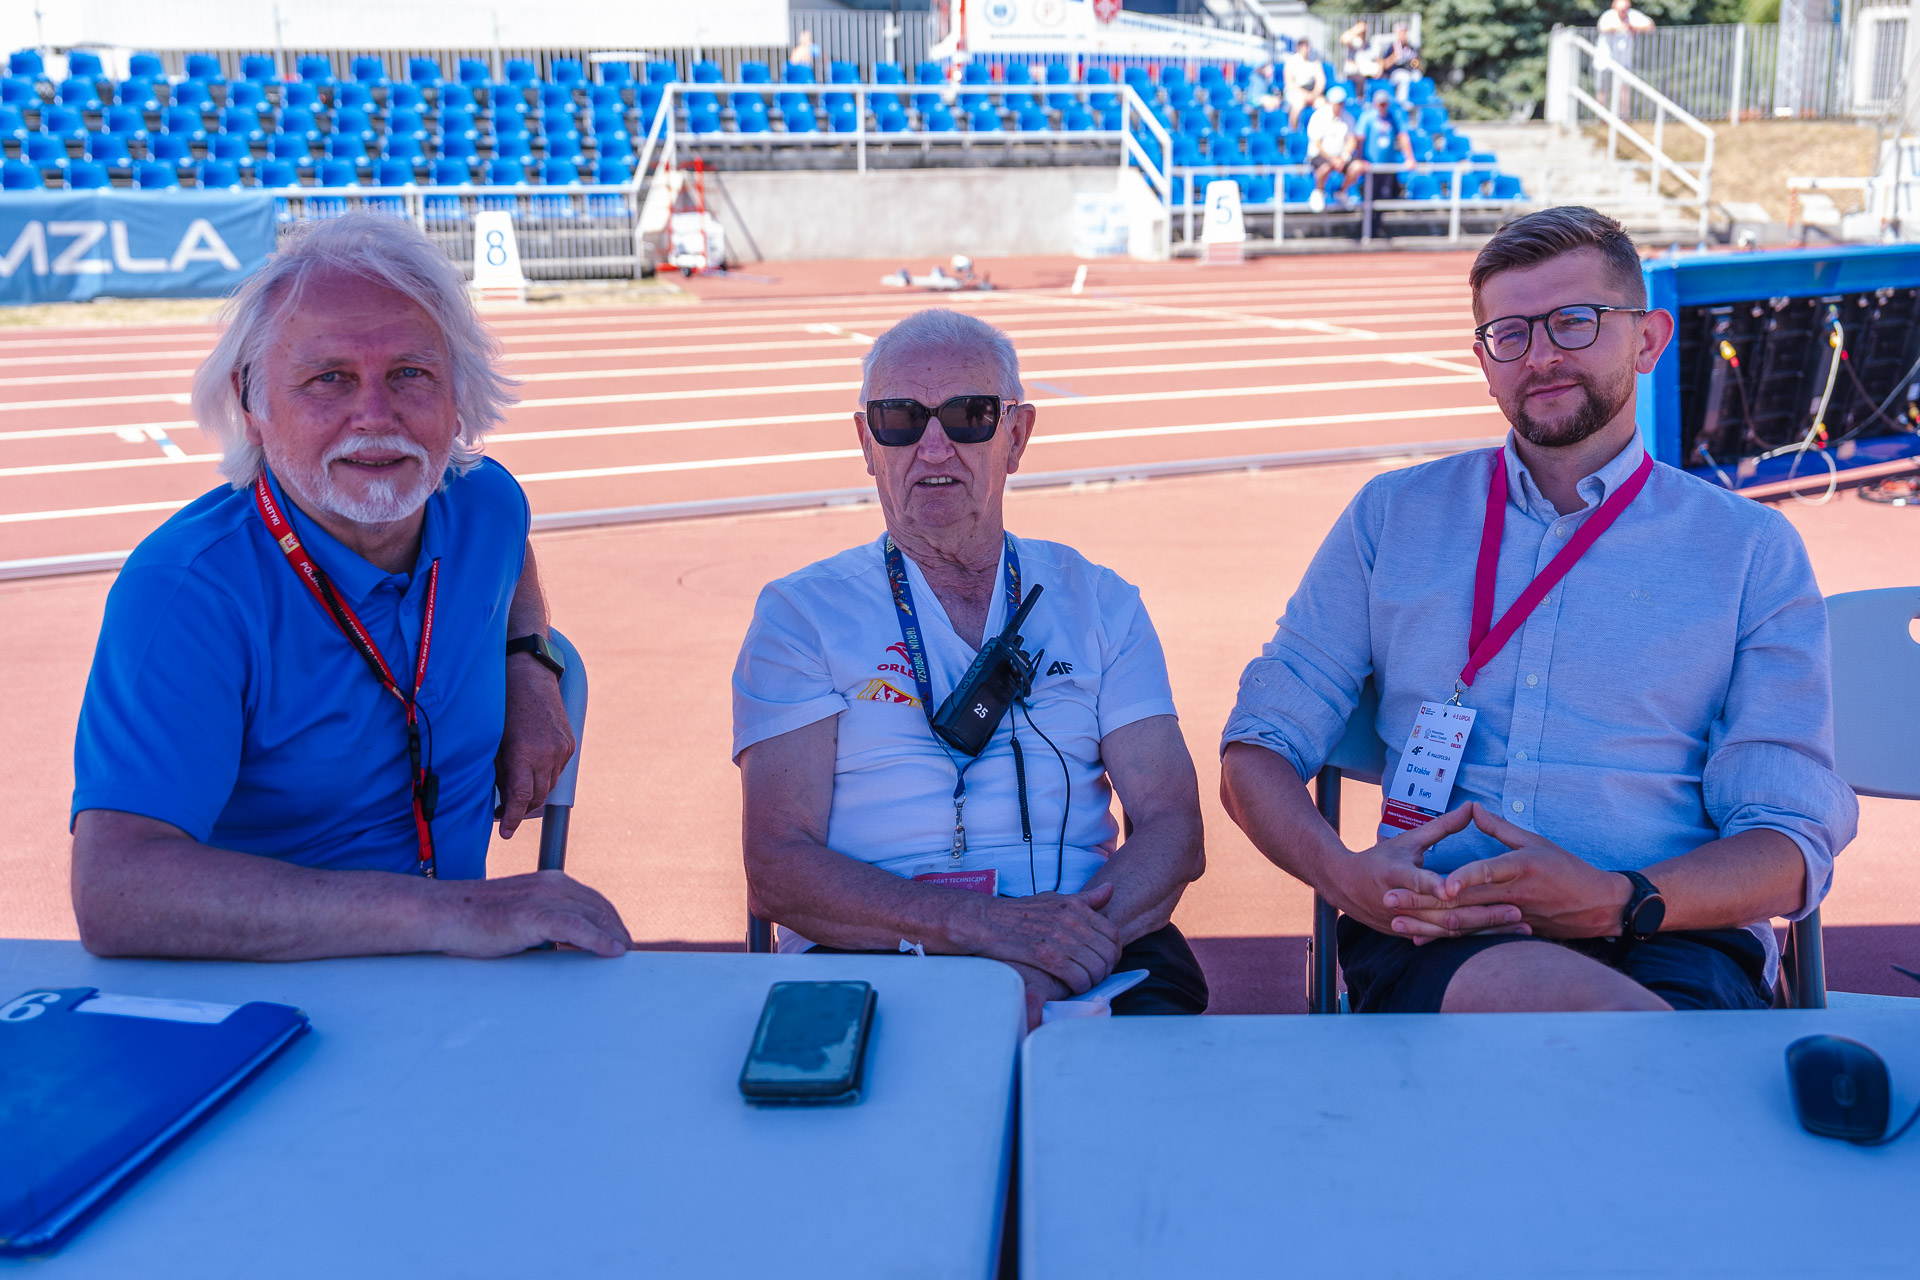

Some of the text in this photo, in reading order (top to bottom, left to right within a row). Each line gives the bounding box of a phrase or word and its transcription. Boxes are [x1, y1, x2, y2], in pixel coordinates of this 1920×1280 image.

[1216, 195, 1232, 225] 5
[0, 218, 242, 277] MZLA
[486, 230, 507, 266] 8
[261, 495, 281, 526] ATLETYKI
[877, 663, 916, 680] ORLE
[973, 703, 989, 718] 25
[949, 876, 987, 884] TECHNICZNY
